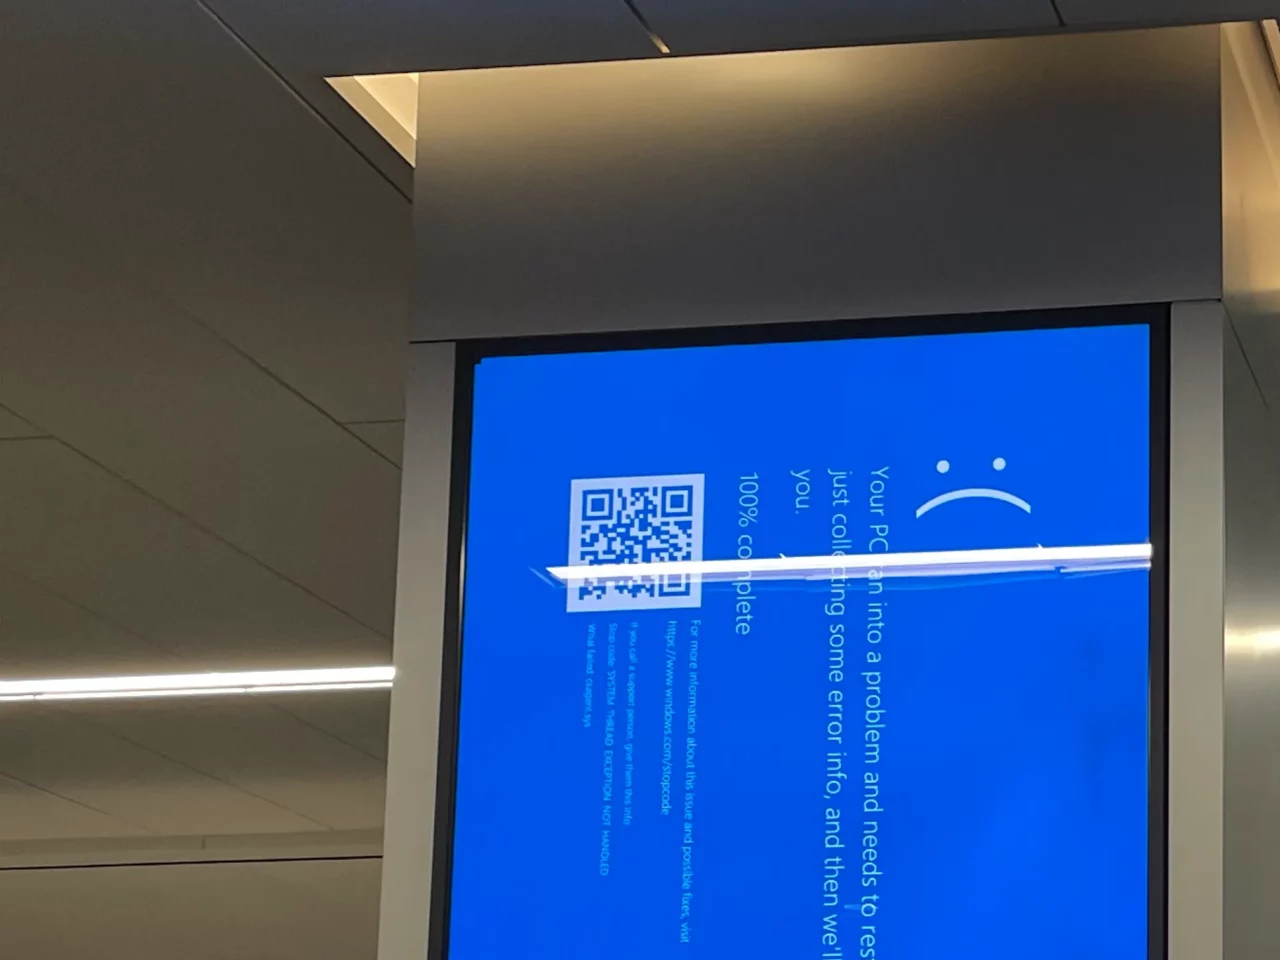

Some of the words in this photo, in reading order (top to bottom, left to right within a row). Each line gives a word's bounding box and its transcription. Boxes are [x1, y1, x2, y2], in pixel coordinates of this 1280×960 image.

[738, 473, 759, 527] 100%
[790, 469, 810, 514] you.
[828, 468, 852, 506] just
[870, 466, 889, 516] Your
[869, 525, 889, 552] PC
[868, 561, 884, 594] an
[691, 620, 701, 637] For
[867, 603, 888, 643] into
[689, 640, 698, 669] more
[829, 624, 844, 682] some
[867, 652, 881, 662] a
[688, 672, 699, 734] information
[827, 691, 843, 744] error
[861, 672, 886, 763] problem
[686, 737, 697, 768] about
[685, 771, 696, 790] this
[824, 752, 847, 799] info,
[864, 772, 884, 812] and
[684, 793, 694, 820] issue
[684, 822, 694, 843] and
[825, 808, 845, 848] and
[681, 846, 693, 889] possible
[862, 822, 883, 886] needs
[823, 856, 845, 907] then
[861, 895, 880, 917] to
[680, 922, 690, 942] visit
